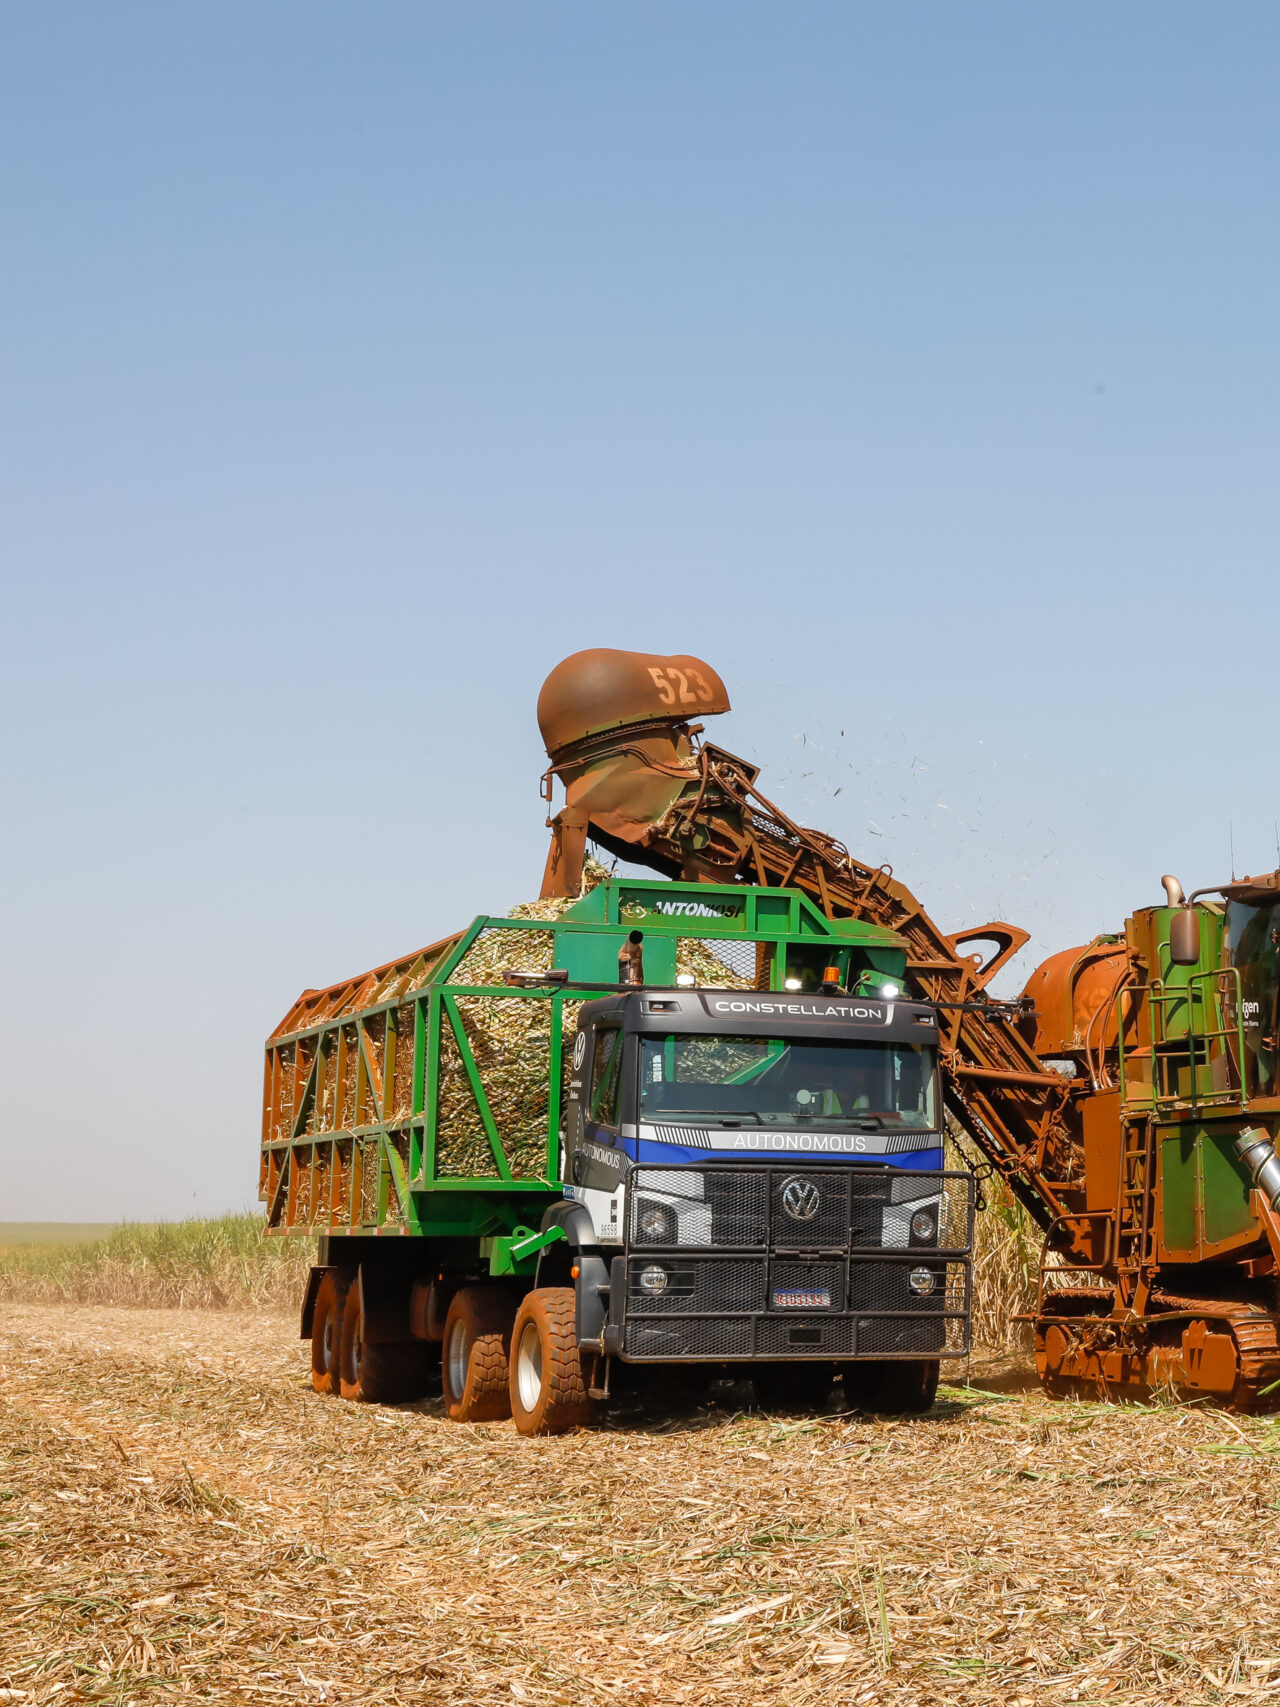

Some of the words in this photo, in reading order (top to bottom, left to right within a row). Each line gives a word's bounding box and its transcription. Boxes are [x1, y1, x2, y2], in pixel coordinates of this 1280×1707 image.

[647, 667, 713, 704] 523
[715, 1001, 882, 1019] CONSTELLATION
[1236, 998, 1259, 1019] rízen
[734, 1134, 867, 1151] AUTONOMOUS
[582, 1142, 620, 1169] AUTONOMOUS
